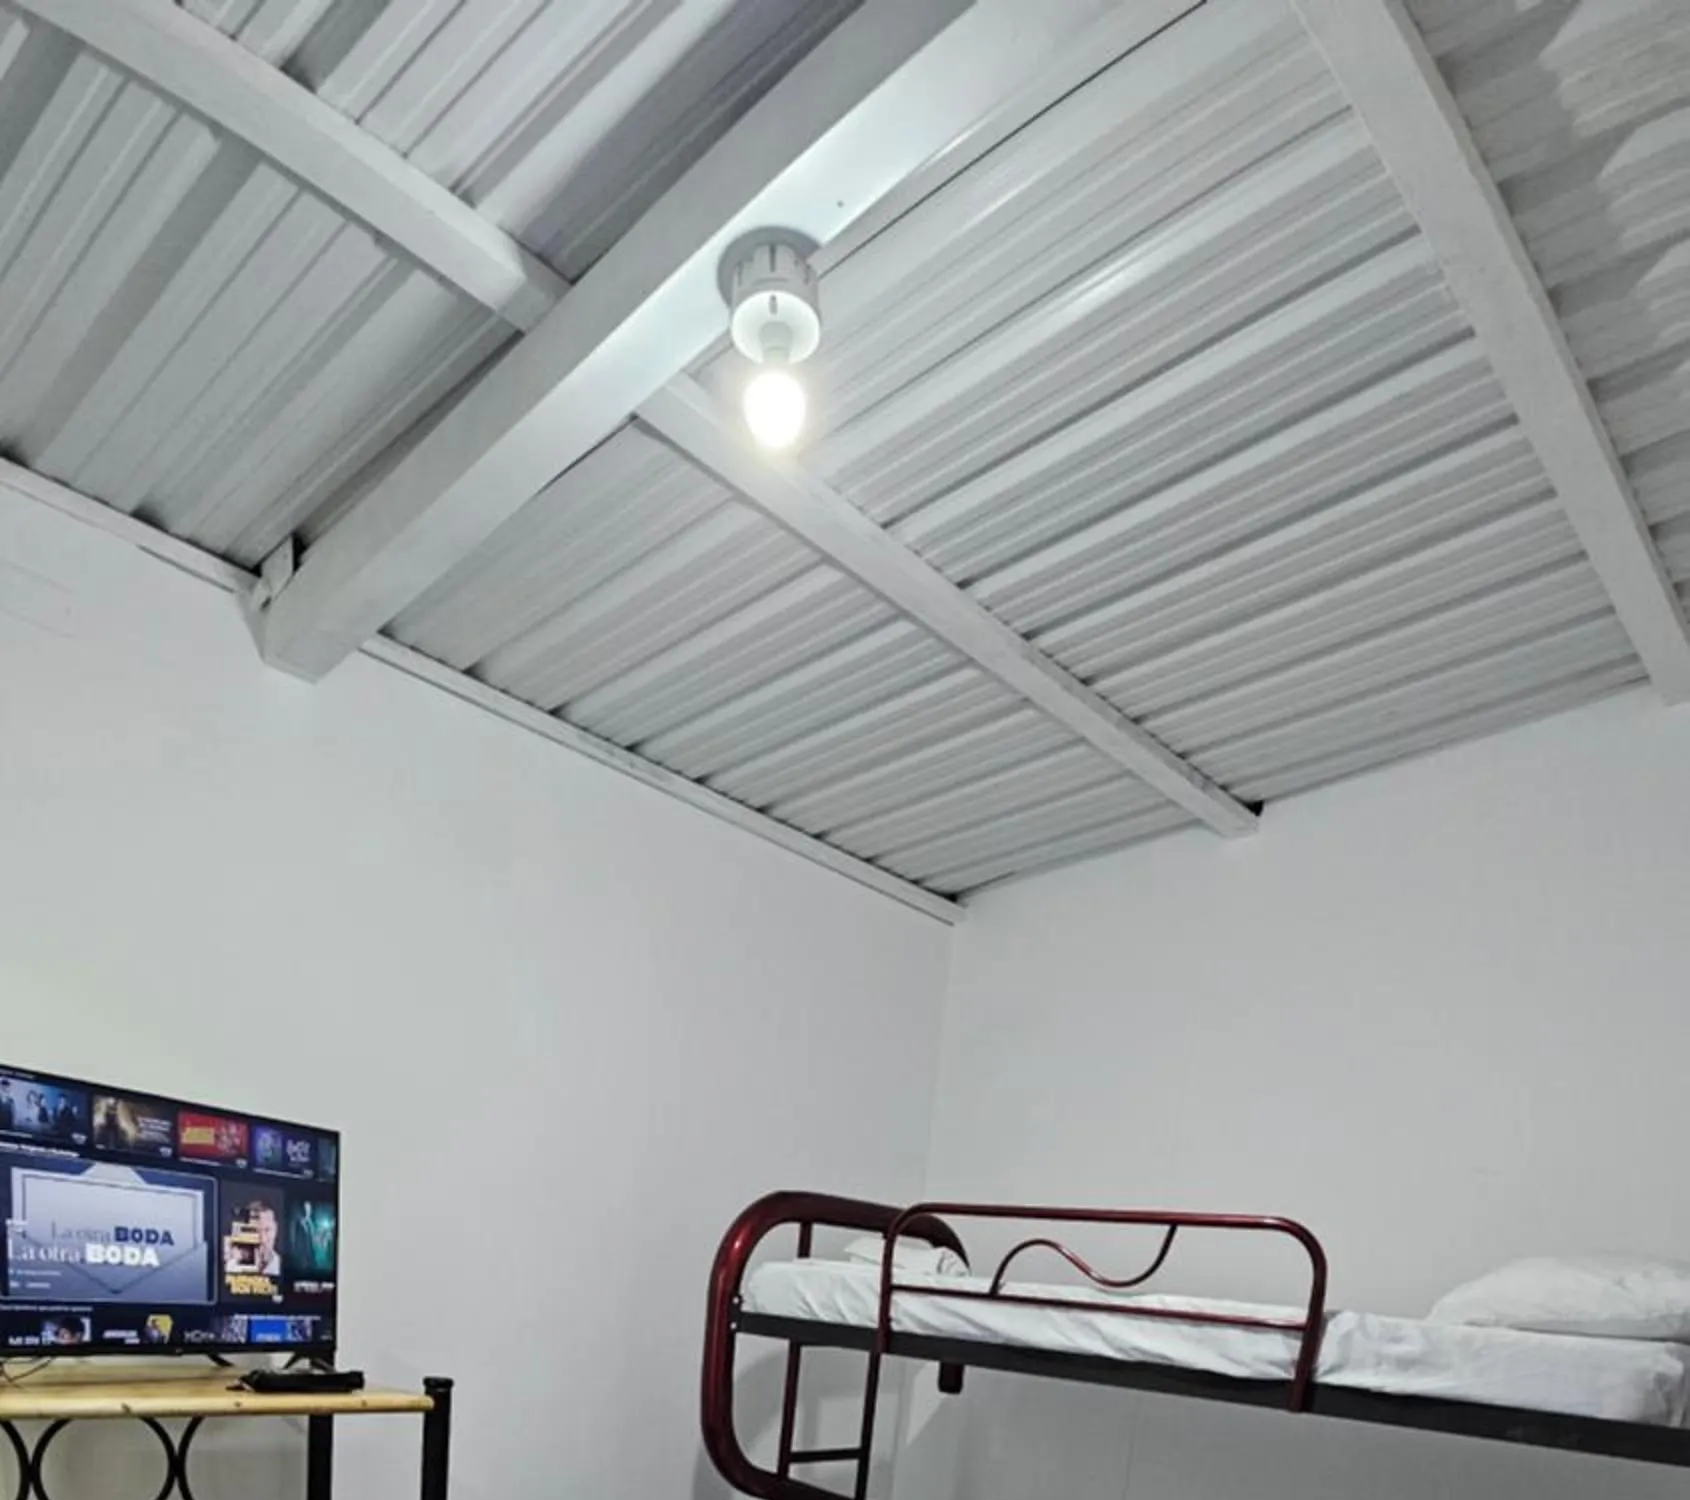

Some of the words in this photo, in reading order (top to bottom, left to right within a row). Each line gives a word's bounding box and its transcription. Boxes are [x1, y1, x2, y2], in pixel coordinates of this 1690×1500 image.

[114, 1226, 174, 1246] BODA
[8, 1238, 35, 1261] La
[39, 1246, 80, 1264] otra
[85, 1243, 160, 1267] BODA
